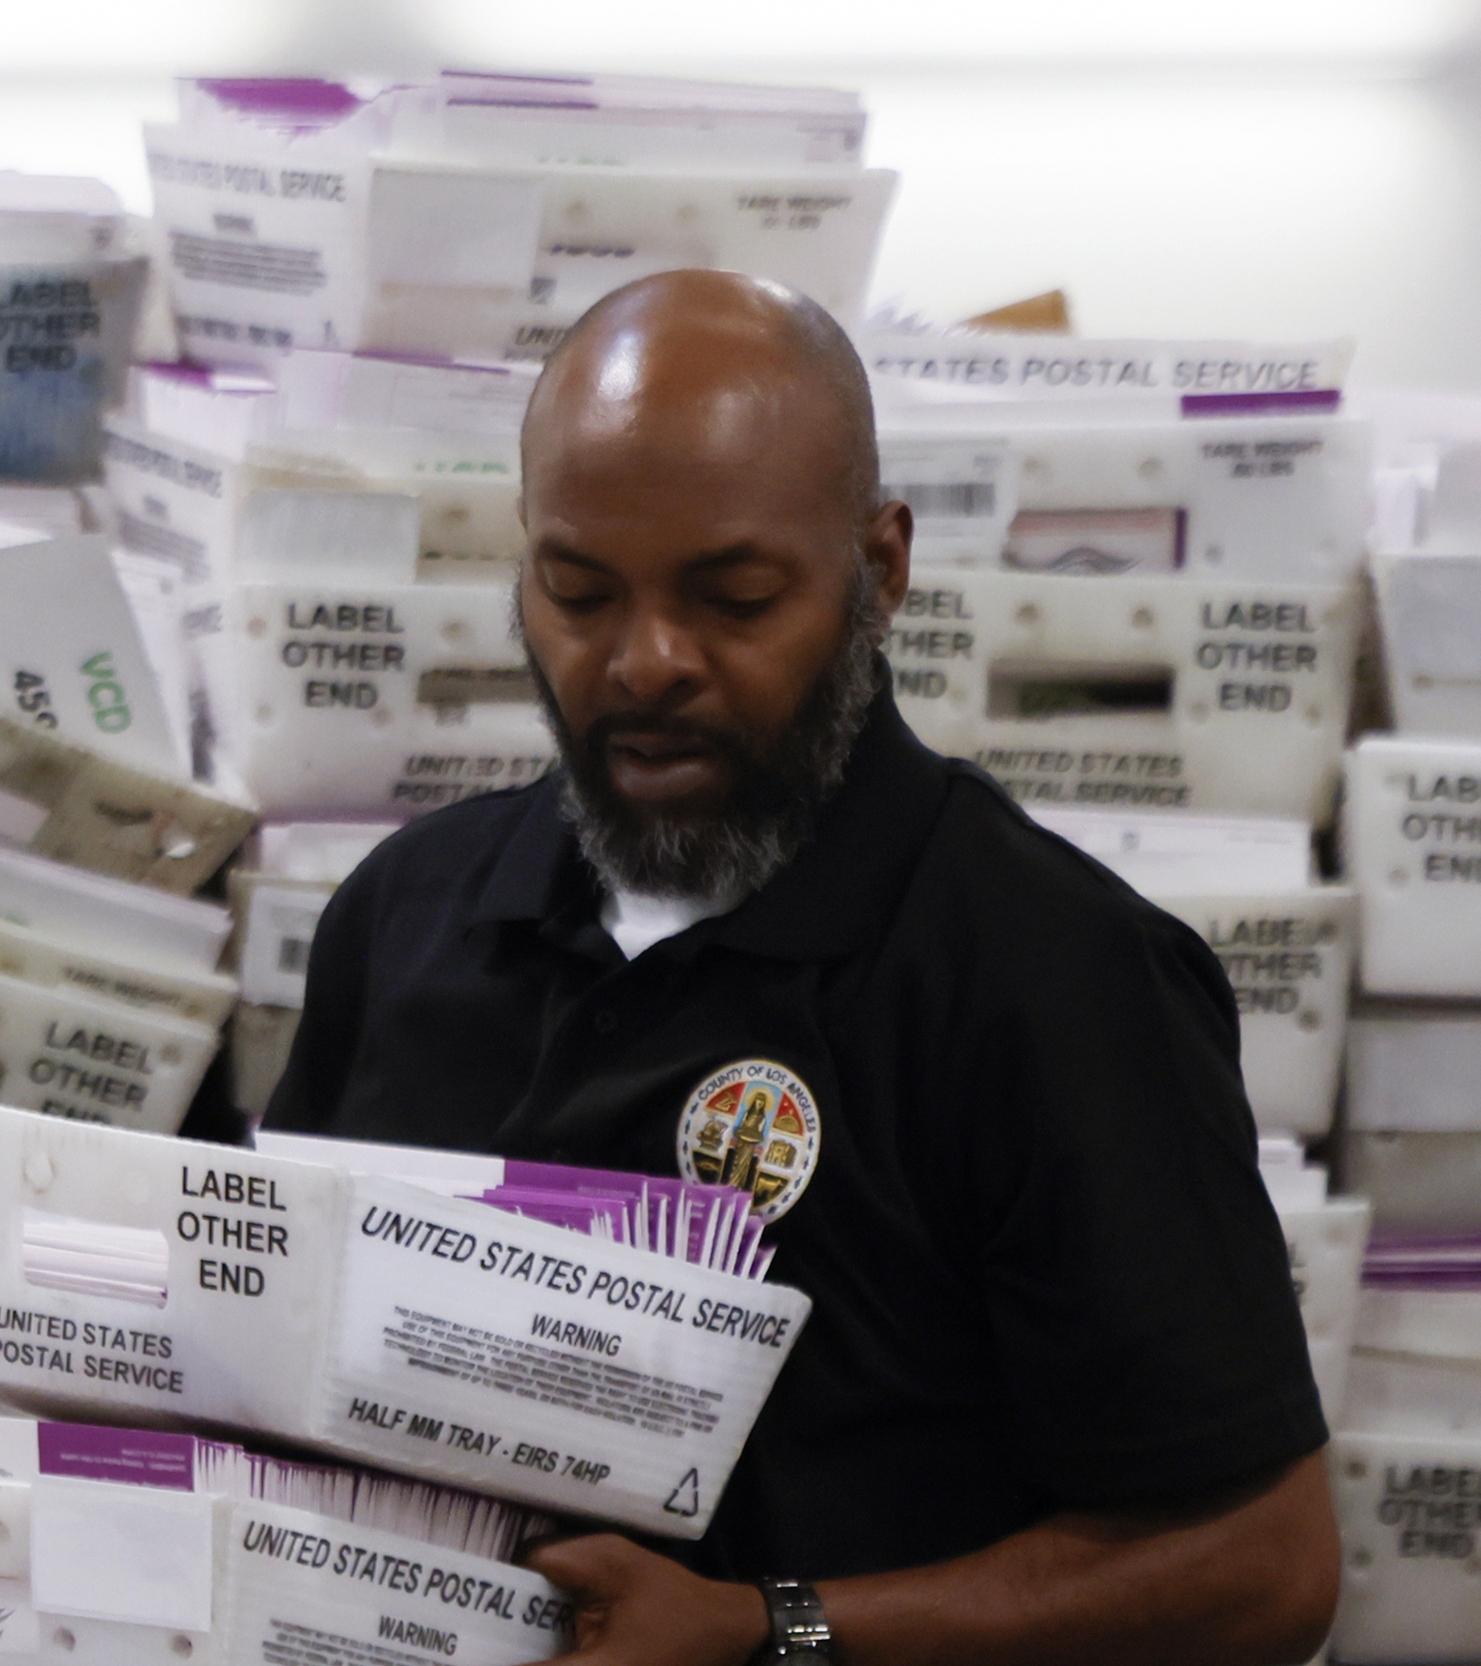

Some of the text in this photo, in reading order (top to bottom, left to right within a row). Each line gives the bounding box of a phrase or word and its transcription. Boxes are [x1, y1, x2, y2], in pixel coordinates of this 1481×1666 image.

[1021, 358, 1157, 387] POSTAL
[1174, 361, 1319, 389] SERVICE
[288, 603, 405, 634] LABEL
[905, 590, 974, 620] BEL
[1202, 603, 1316, 633] LABEL
[282, 641, 405, 670] OTHER
[888, 629, 974, 660] THER
[1197, 642, 1318, 673] OTHER
[79, 651, 133, 734] VCD
[304, 681, 380, 709] END
[895, 670, 947, 699] ND
[1218, 682, 1292, 712] END
[975, 748, 1184, 778] UNITED STATES
[1076, 781, 1193, 808] SERVICE
[1407, 775, 1481, 802] LAB
[1403, 813, 1481, 842] OTH
[1219, 953, 1321, 979] THER
[44, 1020, 154, 1076] LABEL
[30, 1058, 149, 1112] OTHER
[698, 1065, 818, 1133] COUNTY OF LOS ANGELES
[181, 1166, 287, 1212] LABEL
[177, 1211, 289, 1257] OTHER
[199, 1259, 265, 1297] END
[361, 1205, 791, 1350] UNITED STATES POSTAL SERVICE
[82, 1323, 173, 1359] STATES
[531, 1313, 622, 1358] WARNING
[83, 1355, 184, 1395] SERVICE
[348, 1397, 408, 1431] HALF
[407, 1412, 443, 1442] MM
[447, 1422, 501, 1458] TRAY
[512, 1443, 561, 1478] EIRS
[562, 1457, 611, 1487] 74HP
[1385, 1466, 1481, 1496] LABE
[243, 1520, 331, 1569] UNITED
[332, 1544, 422, 1596] STATES
[423, 1568, 515, 1621] POSTAL
[378, 1615, 458, 1656] WARNING
